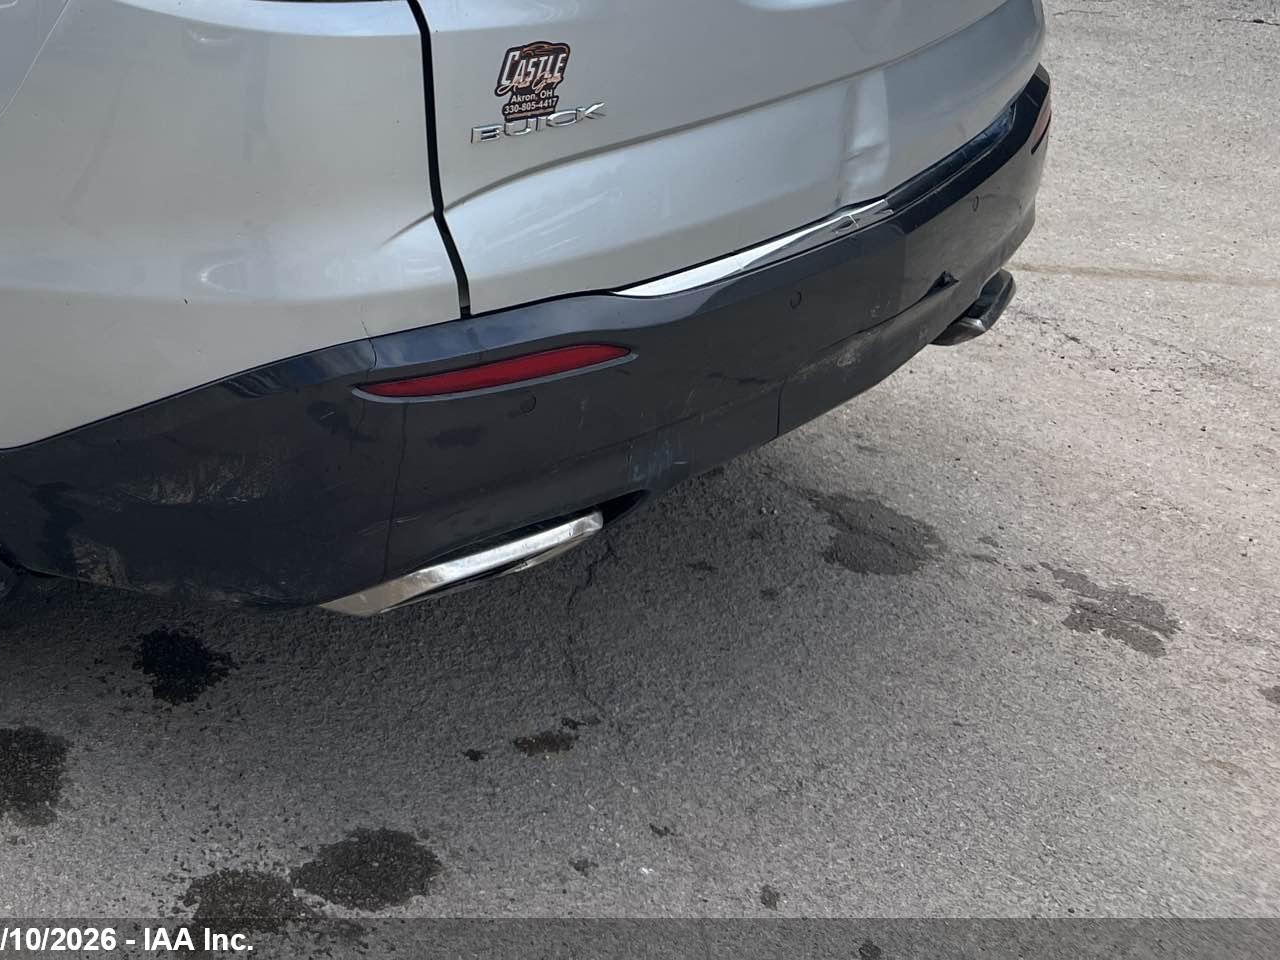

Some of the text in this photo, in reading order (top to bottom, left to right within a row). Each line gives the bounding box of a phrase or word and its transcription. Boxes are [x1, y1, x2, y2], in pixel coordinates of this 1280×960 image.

[501, 51, 567, 85] CASTLE
[504, 98, 558, 114] 330-805-4417
[540, 89, 553, 99] OH
[471, 102, 606, 143] BUICK
